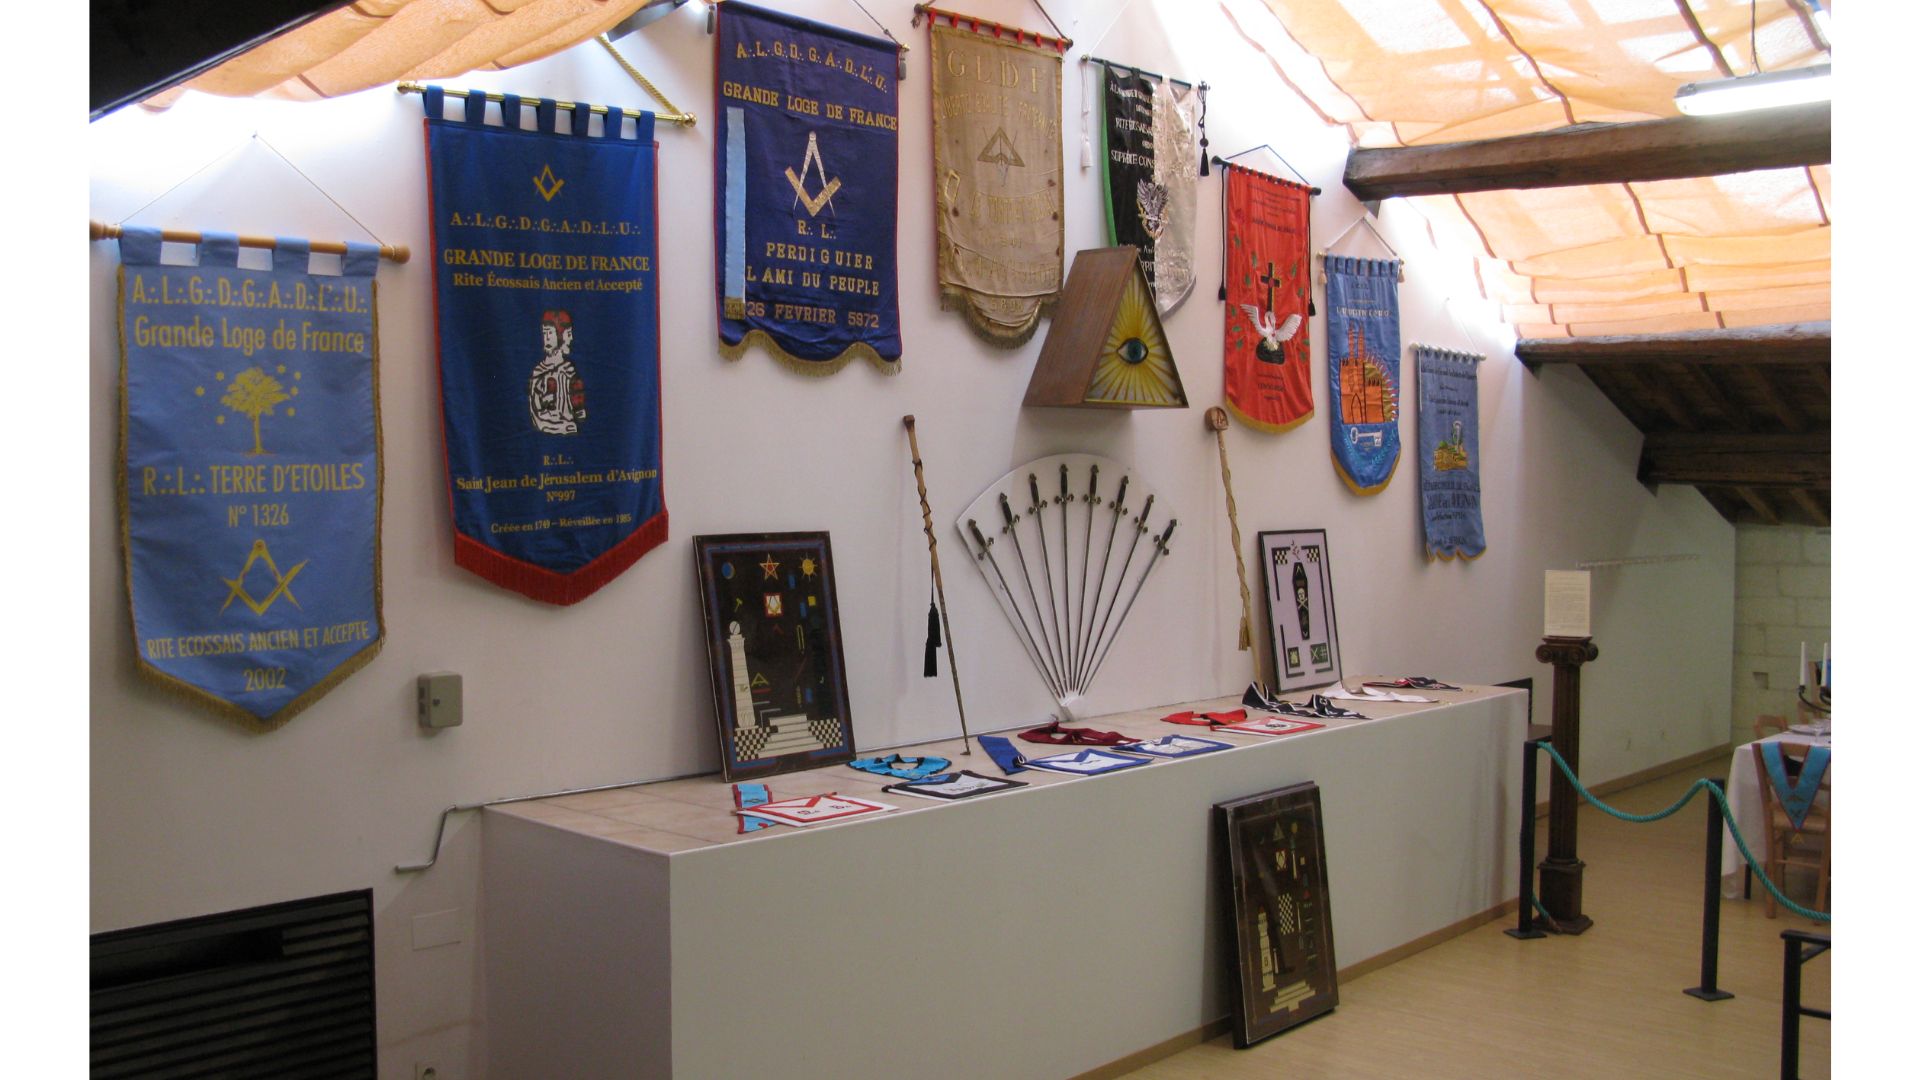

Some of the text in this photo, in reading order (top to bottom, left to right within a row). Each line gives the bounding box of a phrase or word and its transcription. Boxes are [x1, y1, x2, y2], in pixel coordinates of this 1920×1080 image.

[723, 81, 897, 131] GRANDE LOGE DE FRANCE
[444, 248, 650, 272] GRANDE LOGE DE FRANCE
[766, 242, 873, 270] PERDIGUIER
[453, 271, 483, 286] Rite
[543, 276, 582, 291] Ancien
[584, 280, 596, 291] et
[598, 276, 643, 293] Accepté
[747, 266, 880, 296] L AMI DU PEUPLE
[747, 301, 766, 317] 26
[774, 303, 837, 324] FEVRIER
[134, 315, 365, 356] Grande Loge de France
[209, 464, 267, 494] TERRE
[273, 462, 366, 493] D'ETOILES
[456, 477, 483, 490] Saint
[484, 475, 517, 493] Jean
[520, 474, 537, 488] de
[252, 503, 290, 527] 1326
[146, 620, 370, 660] RITE ECOSSAIS ANCIEN ET ACCEPTE
[243, 667, 286, 692] 2002
